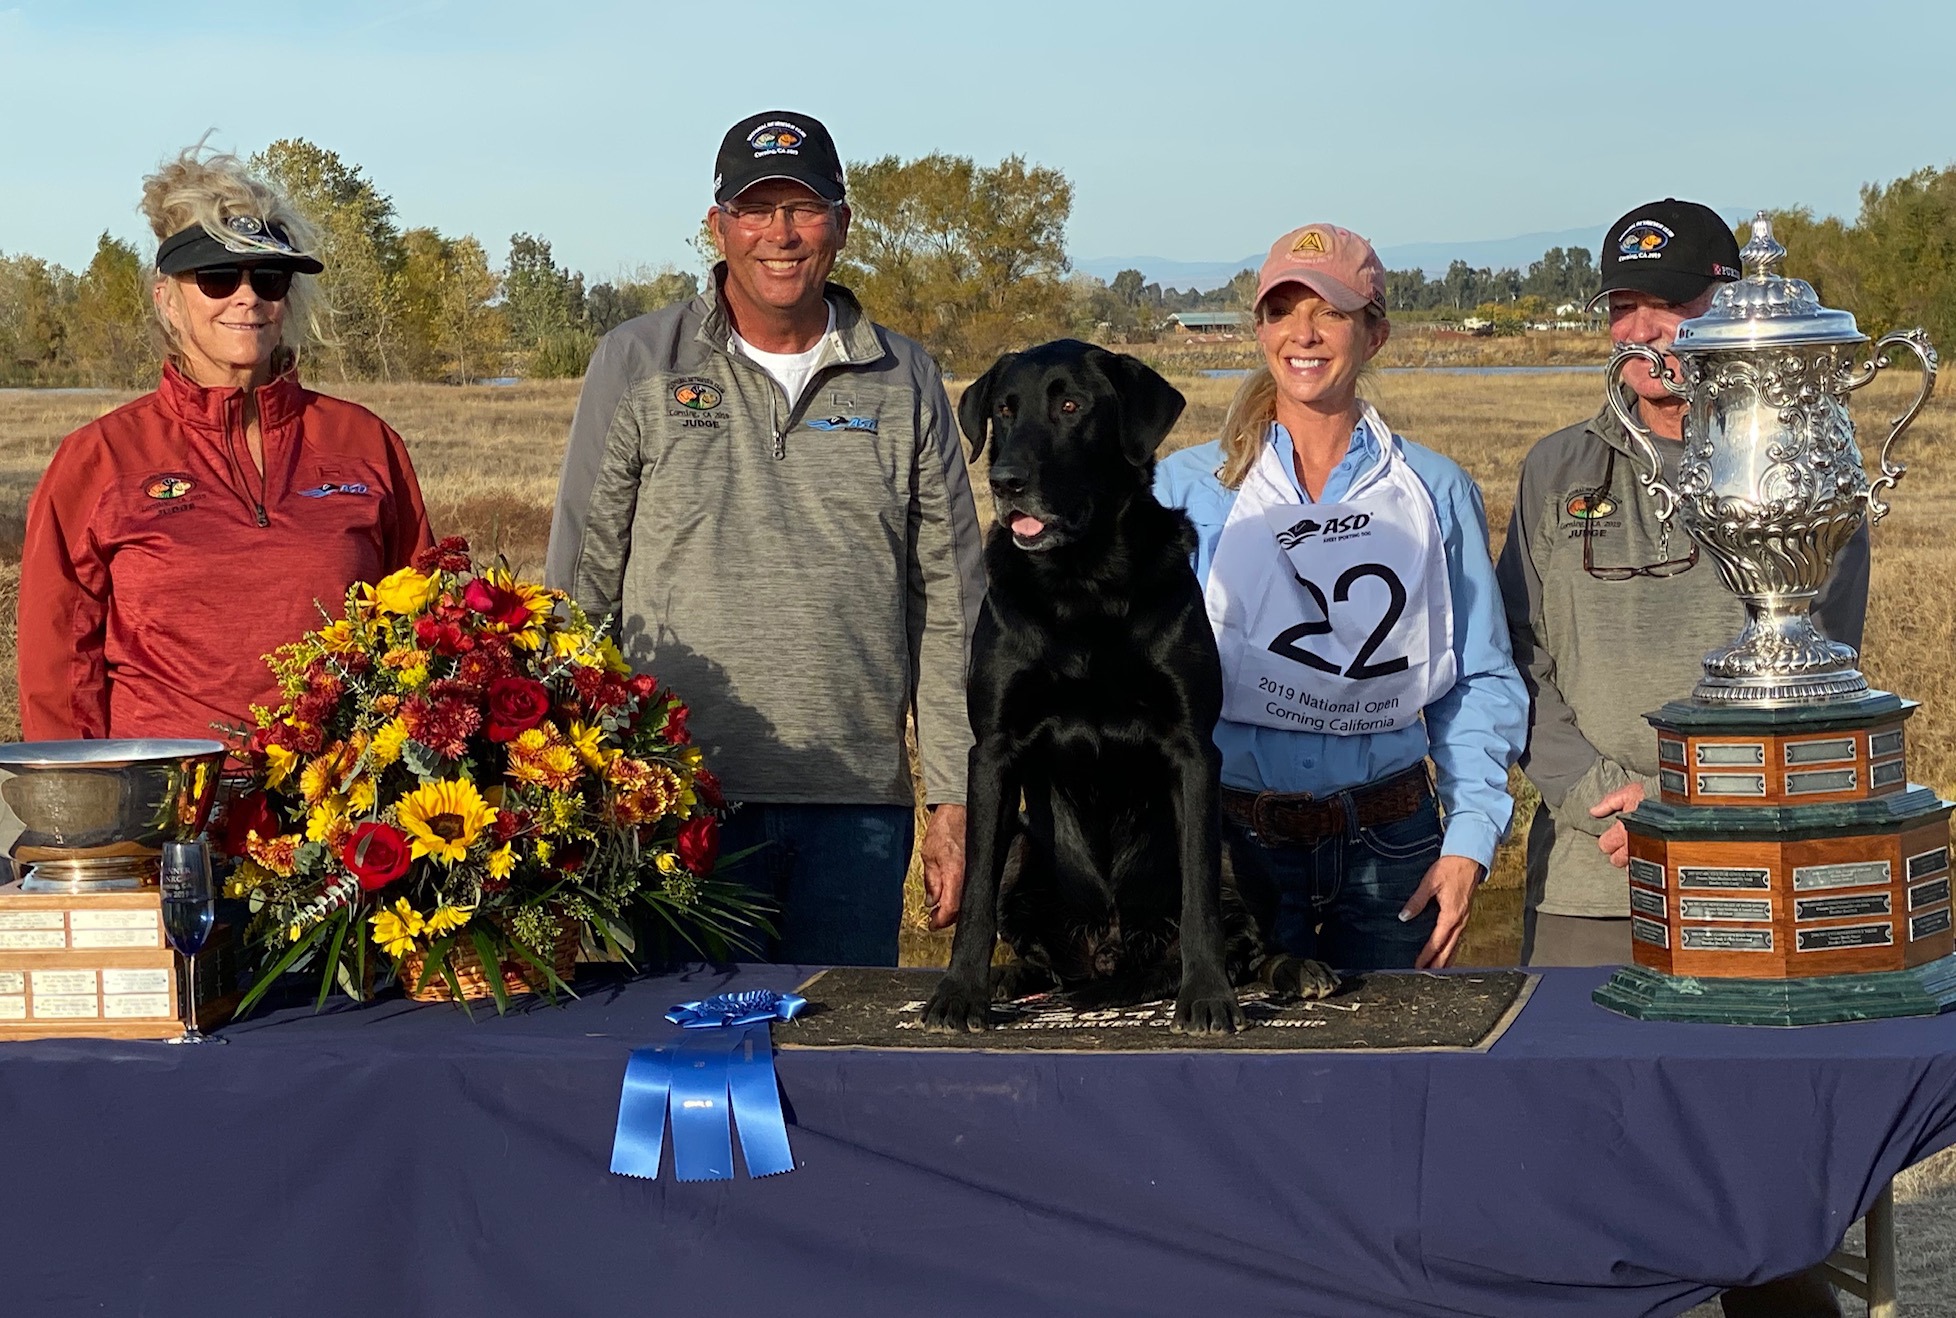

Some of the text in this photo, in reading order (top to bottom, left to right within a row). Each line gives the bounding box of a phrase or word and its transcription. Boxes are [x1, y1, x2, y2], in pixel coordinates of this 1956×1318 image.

[682, 419, 720, 429] JUDGE
[1567, 529, 1608, 539] JUGE
[1267, 563, 1409, 680] 22
[1258, 676, 1399, 715] 2019 National Open
[1265, 702, 1395, 732] Corning California
